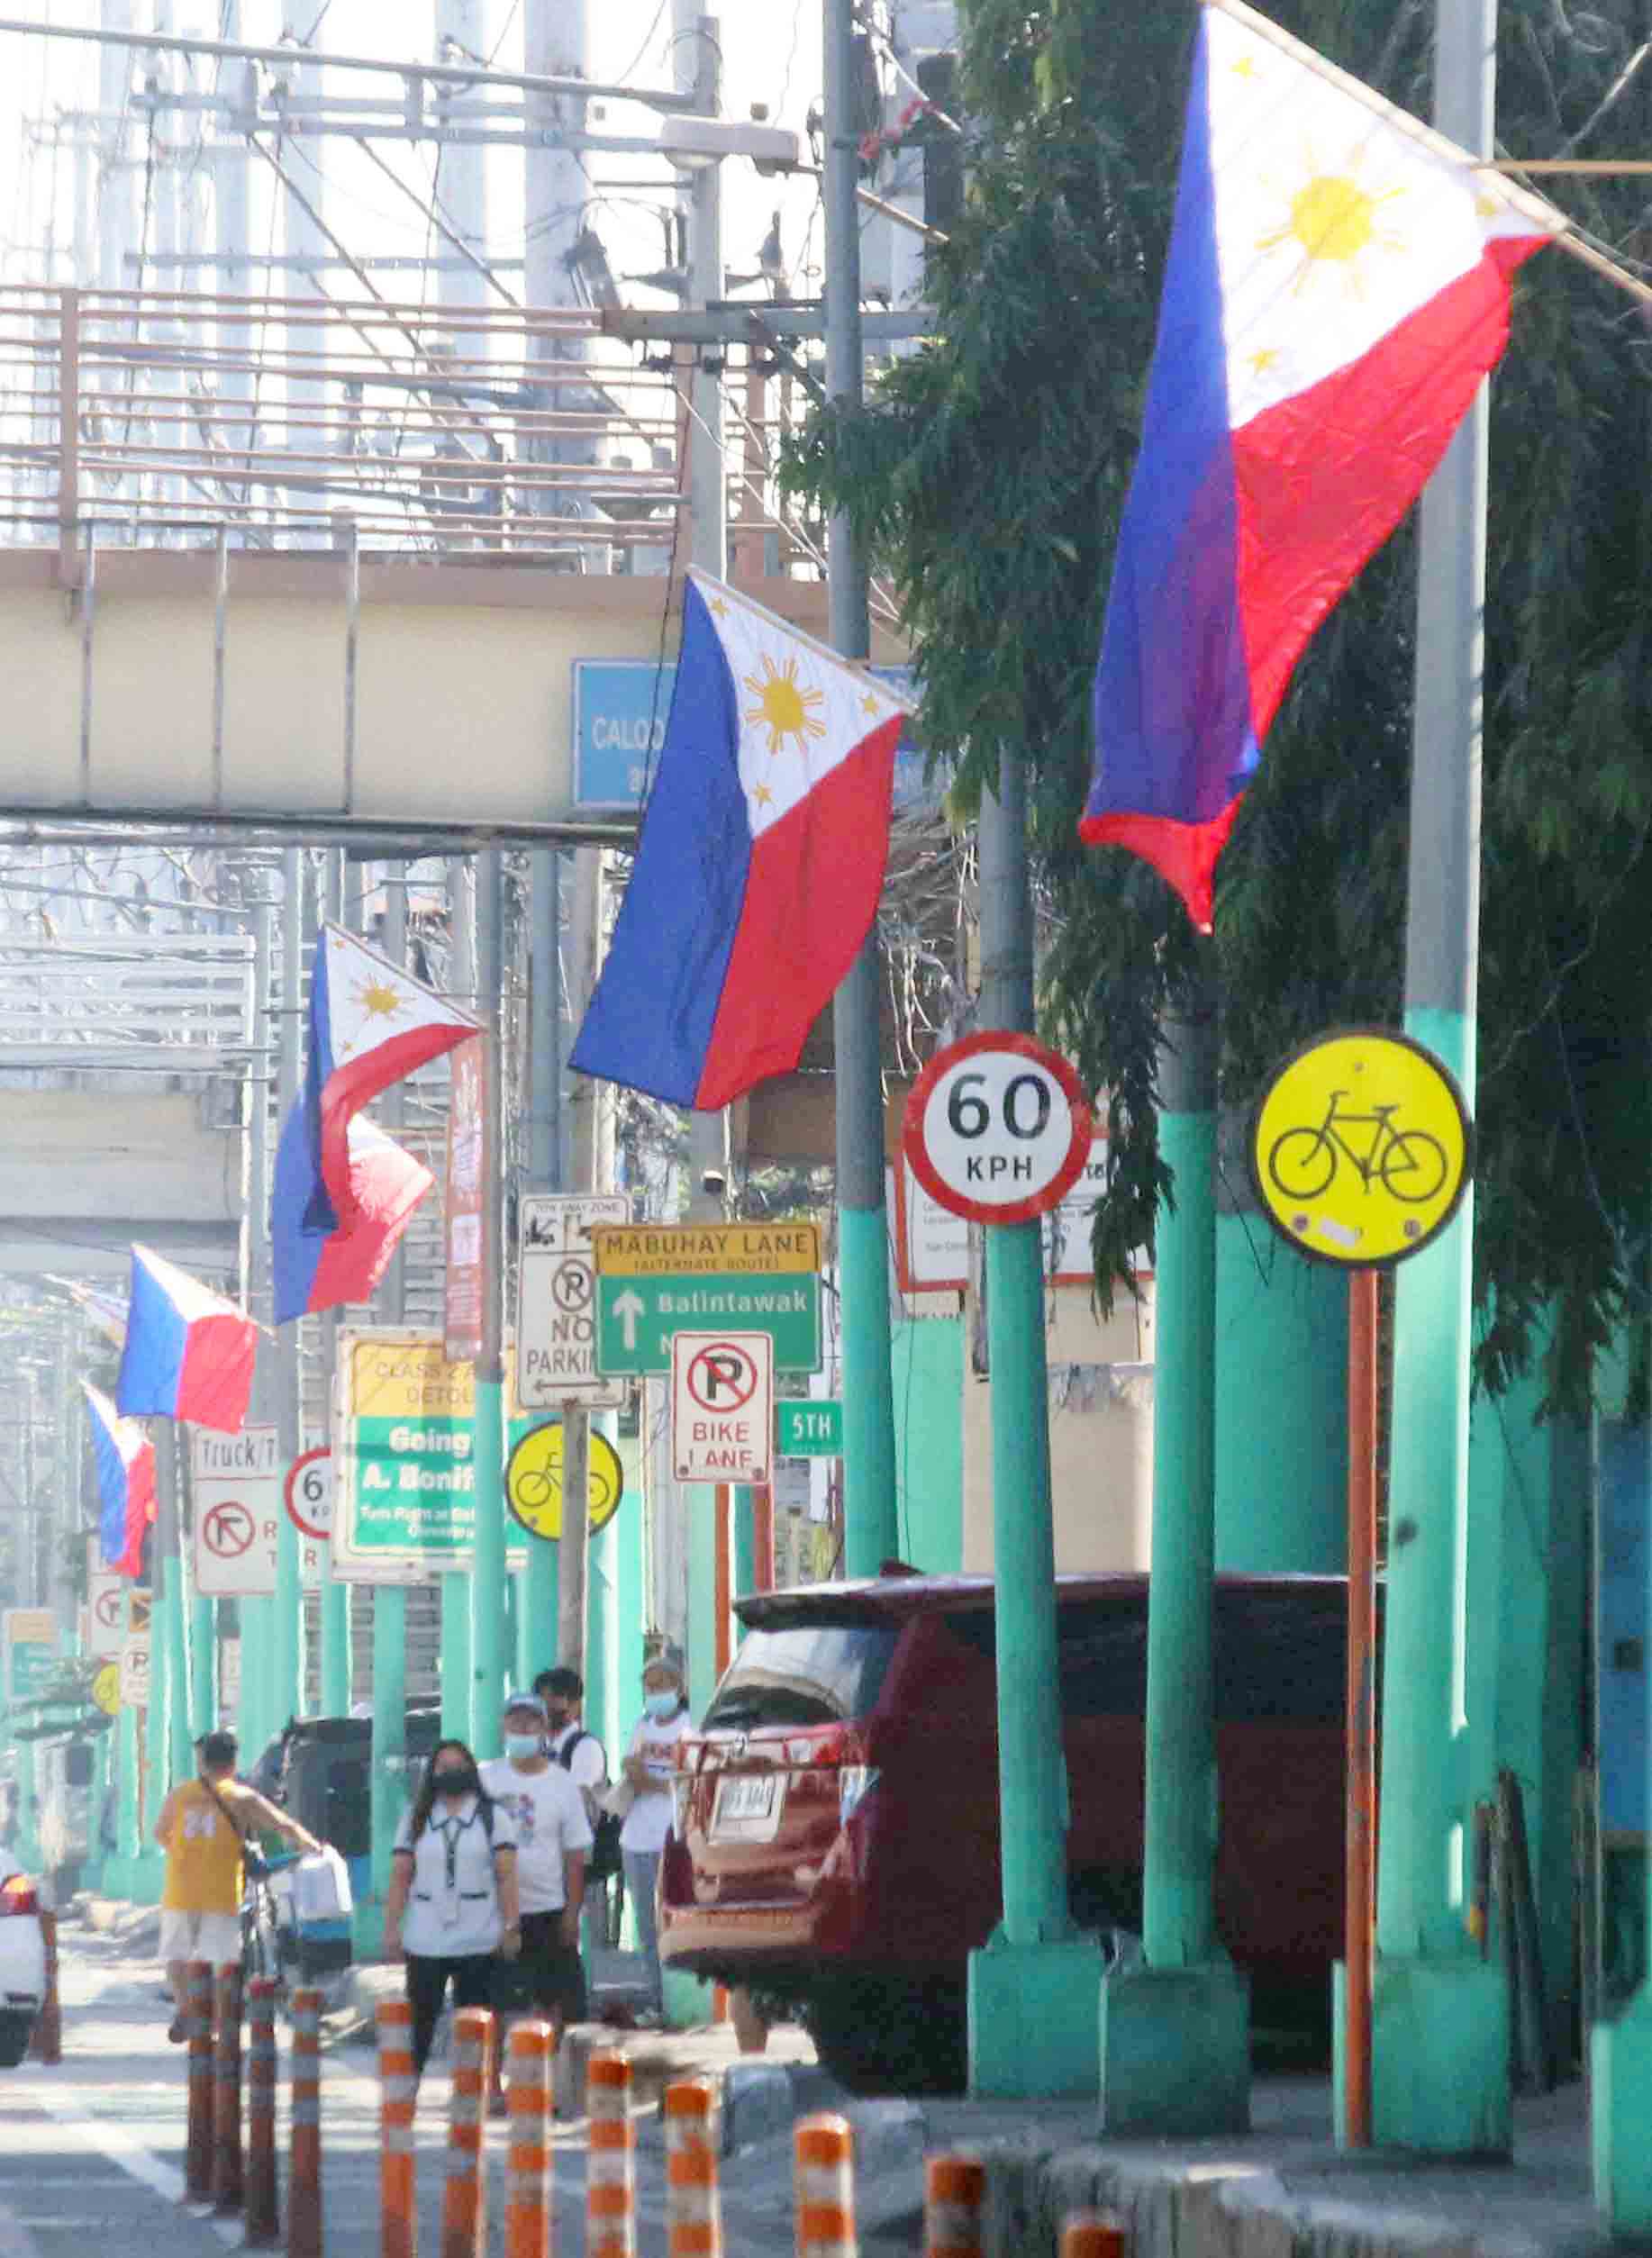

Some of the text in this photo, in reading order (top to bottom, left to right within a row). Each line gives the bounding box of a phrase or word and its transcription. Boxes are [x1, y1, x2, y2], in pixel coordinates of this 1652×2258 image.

[591, 718, 667, 750] CALOO
[948, 1073, 1051, 1140] 60
[966, 1156, 1033, 1181] KPH
[591, 1201, 620, 1212] ZONE
[605, 1231, 809, 1255] MABUHAY LANE
[658, 1289, 809, 1313] Balintawak
[552, 1317, 595, 1342] NO
[526, 1348, 592, 1375] PARKI
[406, 1384, 477, 1404] DETOU
[693, 1421, 749, 1442] BIKE
[792, 1412, 831, 1440] 5TH
[202, 1435, 275, 1468] Truck/T
[388, 1426, 472, 1458] Going
[688, 1449, 753, 1468] LANE
[362, 1462, 476, 1492] A. Bonif
